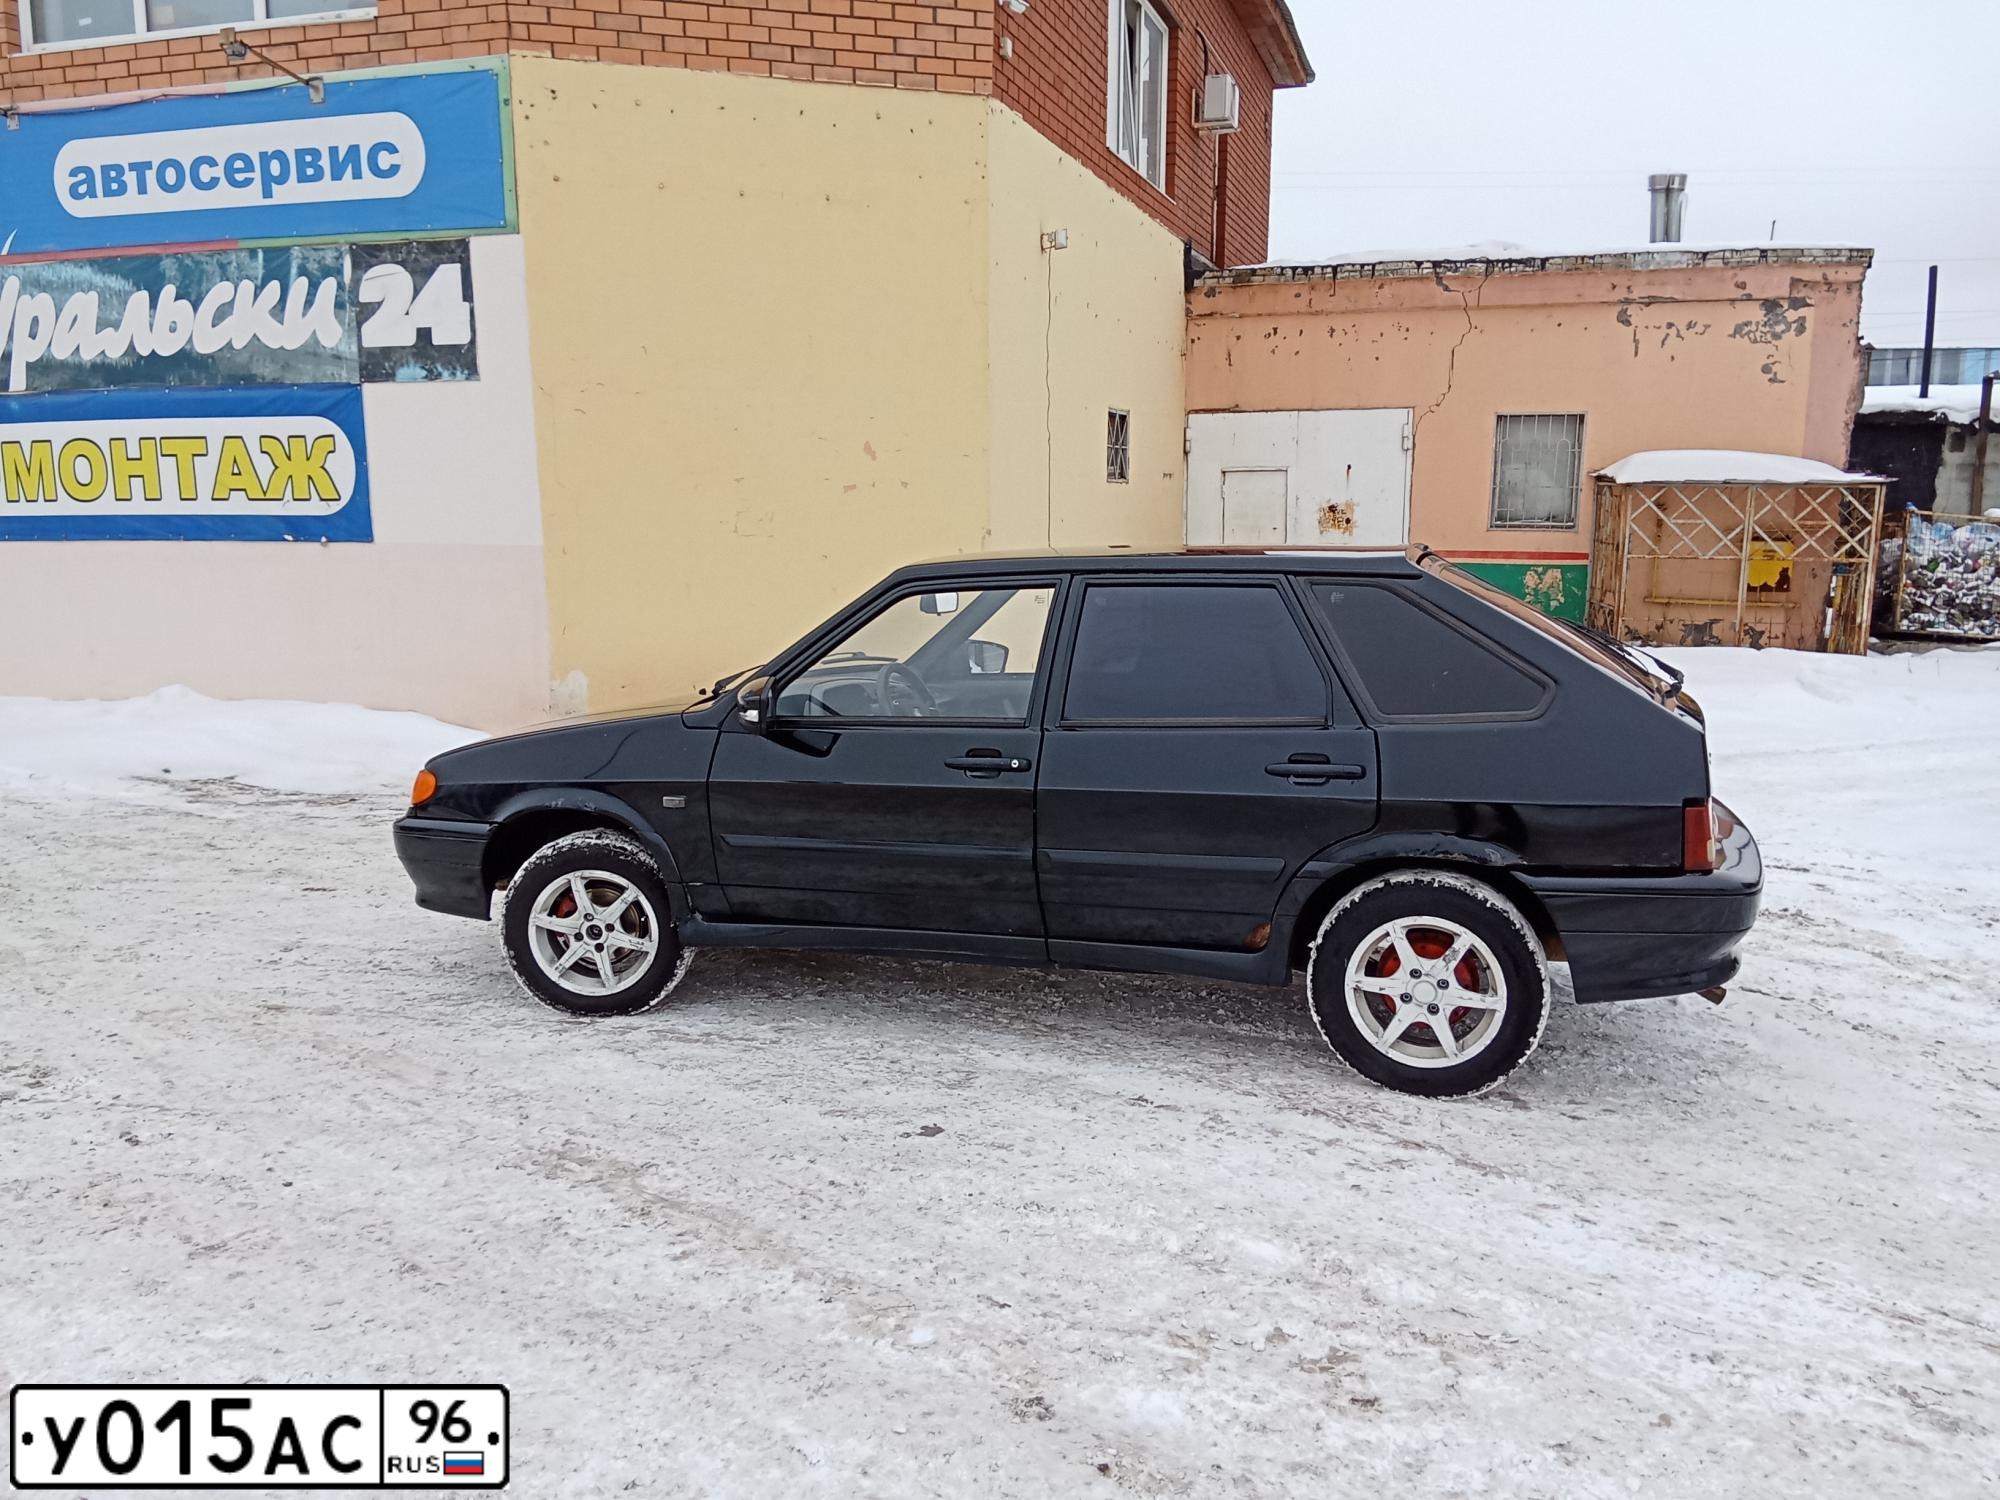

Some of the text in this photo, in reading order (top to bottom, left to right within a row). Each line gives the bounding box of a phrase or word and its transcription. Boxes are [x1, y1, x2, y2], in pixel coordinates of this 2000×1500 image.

[67, 141, 401, 201] автосервис
[358, 263, 471, 348] 24
[0, 434, 341, 502] МОНТАЖ
